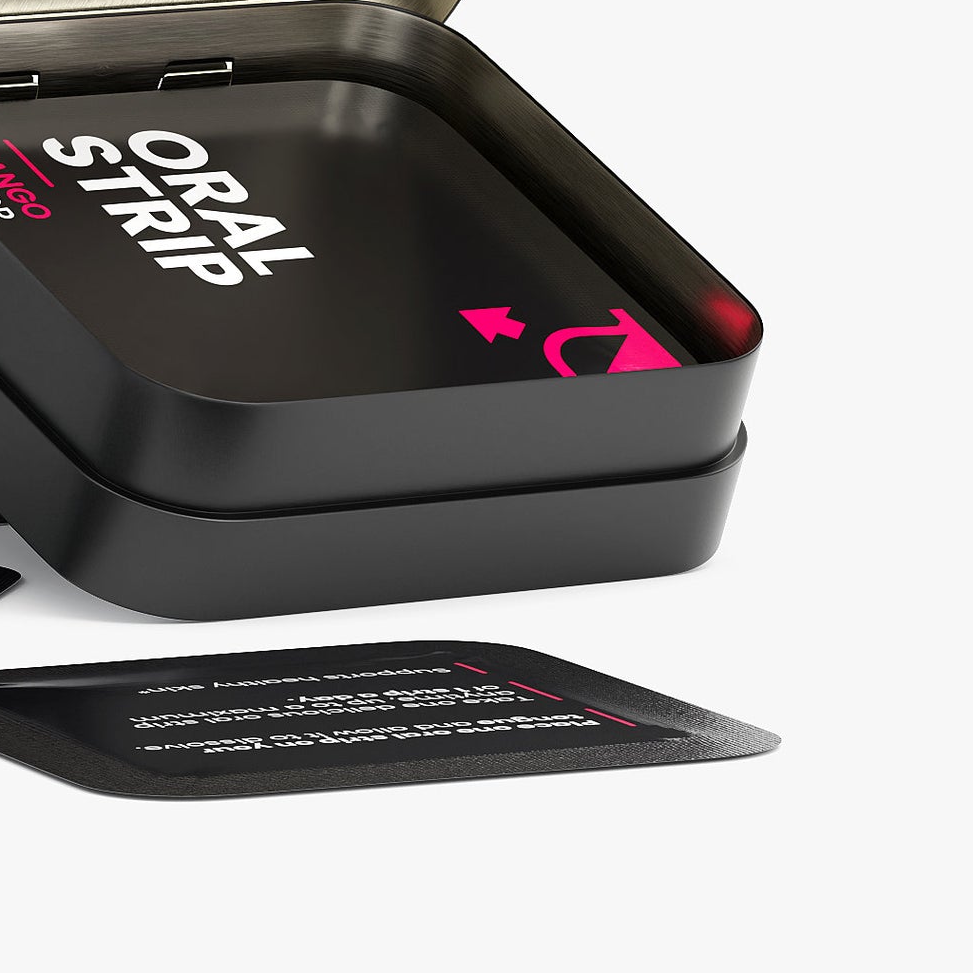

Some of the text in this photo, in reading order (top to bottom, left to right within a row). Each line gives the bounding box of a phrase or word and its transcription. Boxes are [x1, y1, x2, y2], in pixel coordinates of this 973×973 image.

[127, 130, 315, 277] ORAL
[42, 135, 244, 286] STRIP
[323, 668, 451, 679] Supports
[214, 676, 320, 688] healthy
[383, 688, 450, 697] strip
[287, 694, 354, 703] day.
[347, 698, 386, 706] up
[129, 706, 279, 722] maximum
[133, 696, 534, 729] Take one delicious oral strip
[477, 714, 584, 724] tongue
[333, 726, 408, 736] allow
[413, 721, 472, 730] and
[204, 720, 601, 753] Place one oral strip on your
[135, 736, 263, 750] dissolve.
